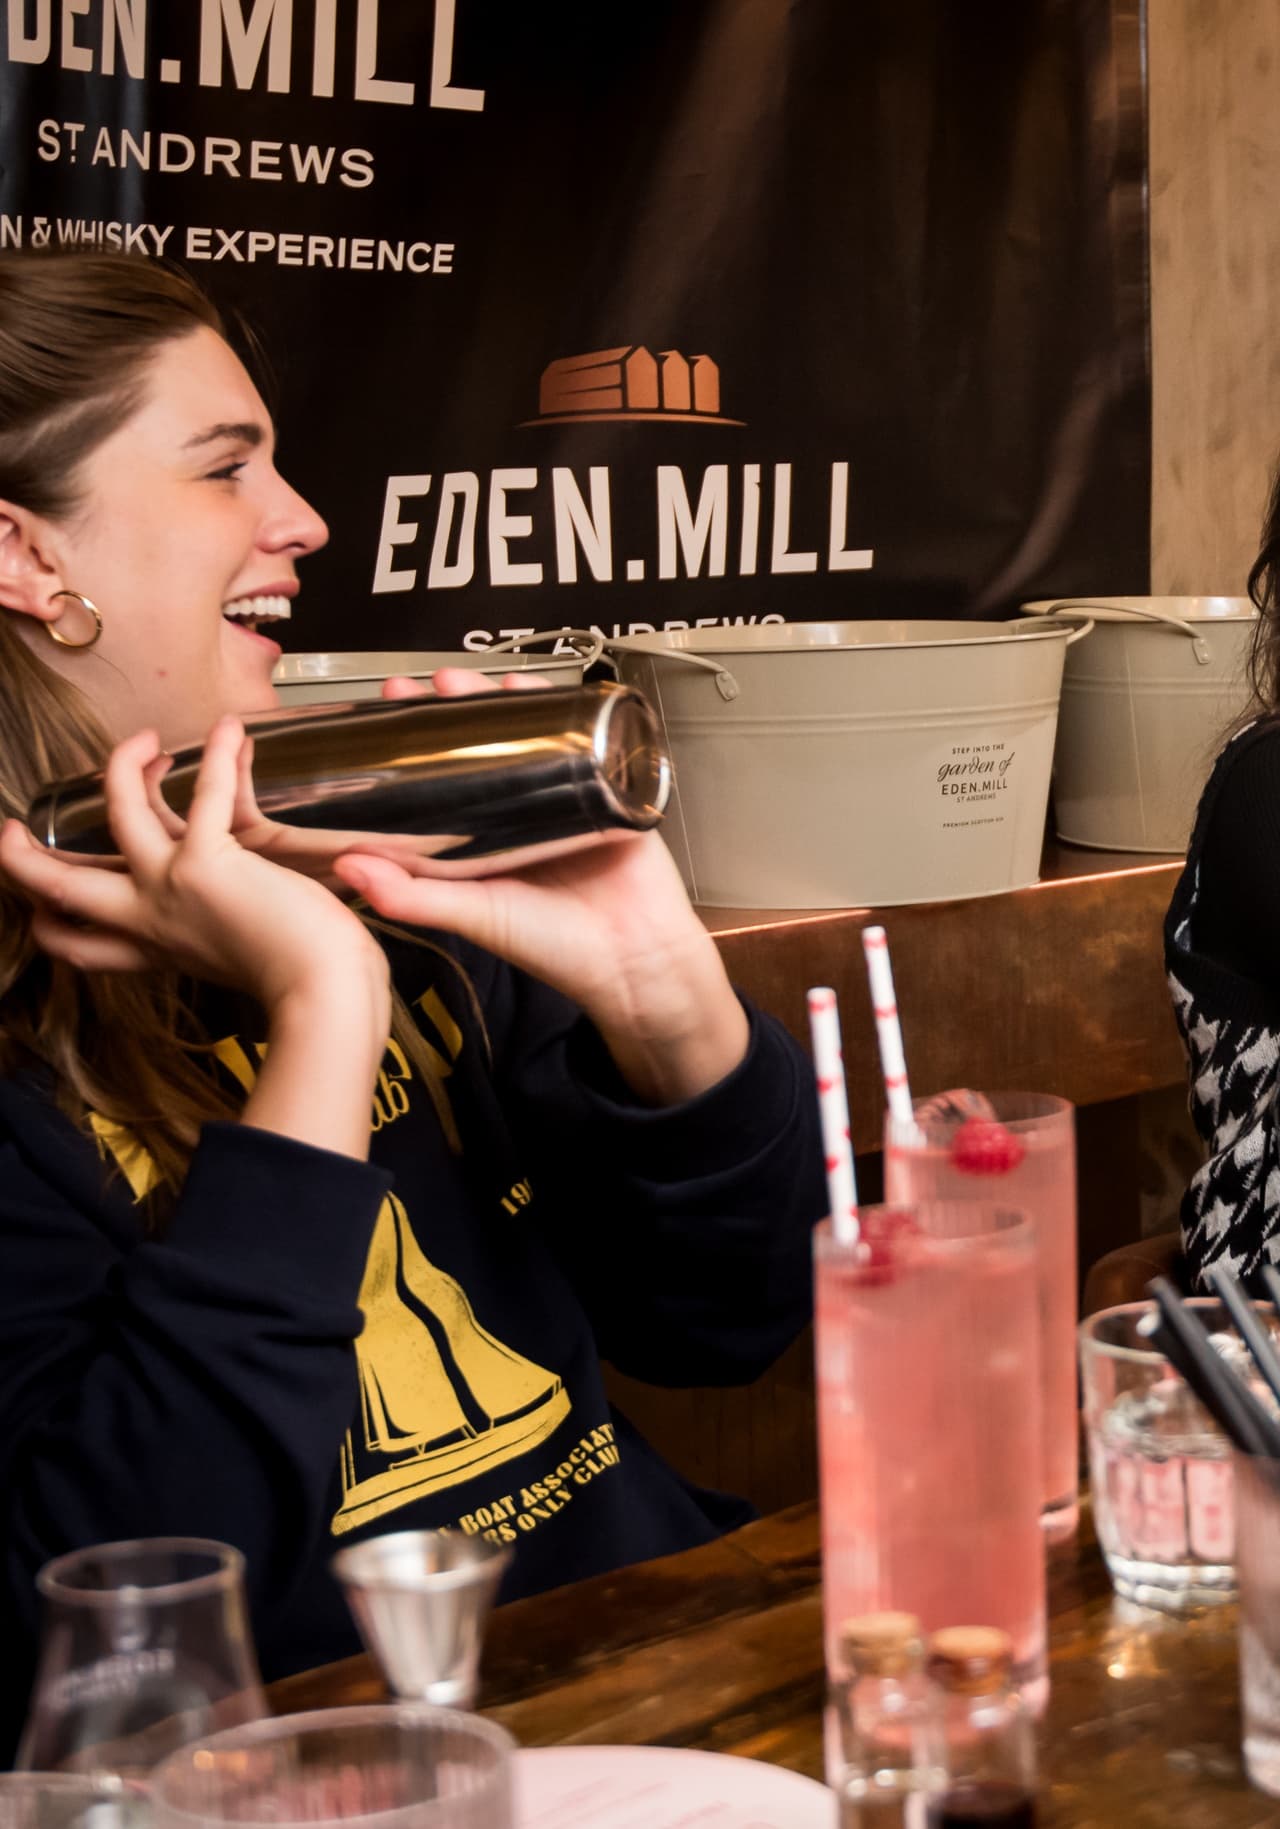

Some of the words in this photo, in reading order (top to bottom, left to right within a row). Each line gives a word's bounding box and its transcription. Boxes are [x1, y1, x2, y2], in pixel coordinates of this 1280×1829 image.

[7, 0, 486, 112] DEN.MILL
[91, 126, 376, 189] ANDREWS
[31, 216, 52, 248] &
[56, 218, 175, 257] WHISKY
[186, 226, 455, 273] EXPERIENCE
[372, 461, 874, 594] EDEN.MILL
[937, 756, 995, 782] garden
[998, 751, 1015, 777] of
[952, 746, 970, 755] STEP
[973, 745, 991, 753] INTO
[993, 743, 1004, 751] THE
[941, 778, 1008, 796] EDEN.MILL
[459, 1495, 517, 1536] BOAT
[482, 1522, 518, 1546] RS
[516, 1484, 573, 1532] ONLY
[573, 1444, 621, 1485] CLU
